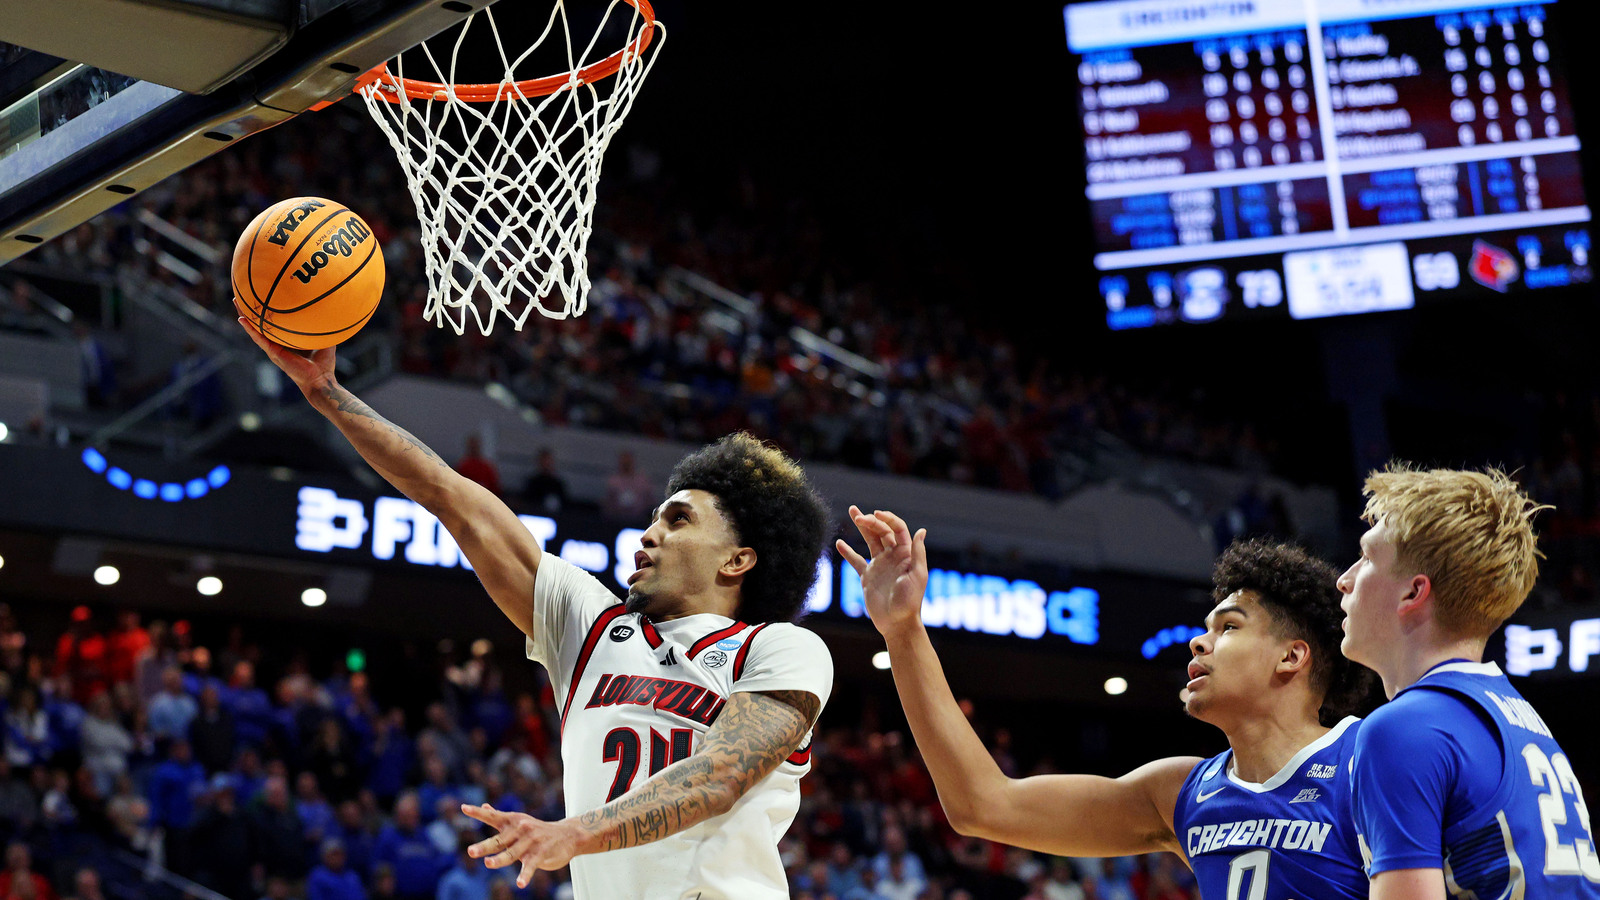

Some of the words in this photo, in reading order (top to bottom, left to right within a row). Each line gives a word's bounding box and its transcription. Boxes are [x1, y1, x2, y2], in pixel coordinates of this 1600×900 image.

[267, 199, 326, 247] NCAA
[293, 216, 370, 284] Wilson
[1236, 268, 1282, 308] 73
[613, 628, 632, 638] JB
[1311, 763, 1324, 771] BE
[1520, 742, 1600, 884] 23
[1187, 818, 1333, 858] CREIGHTON
